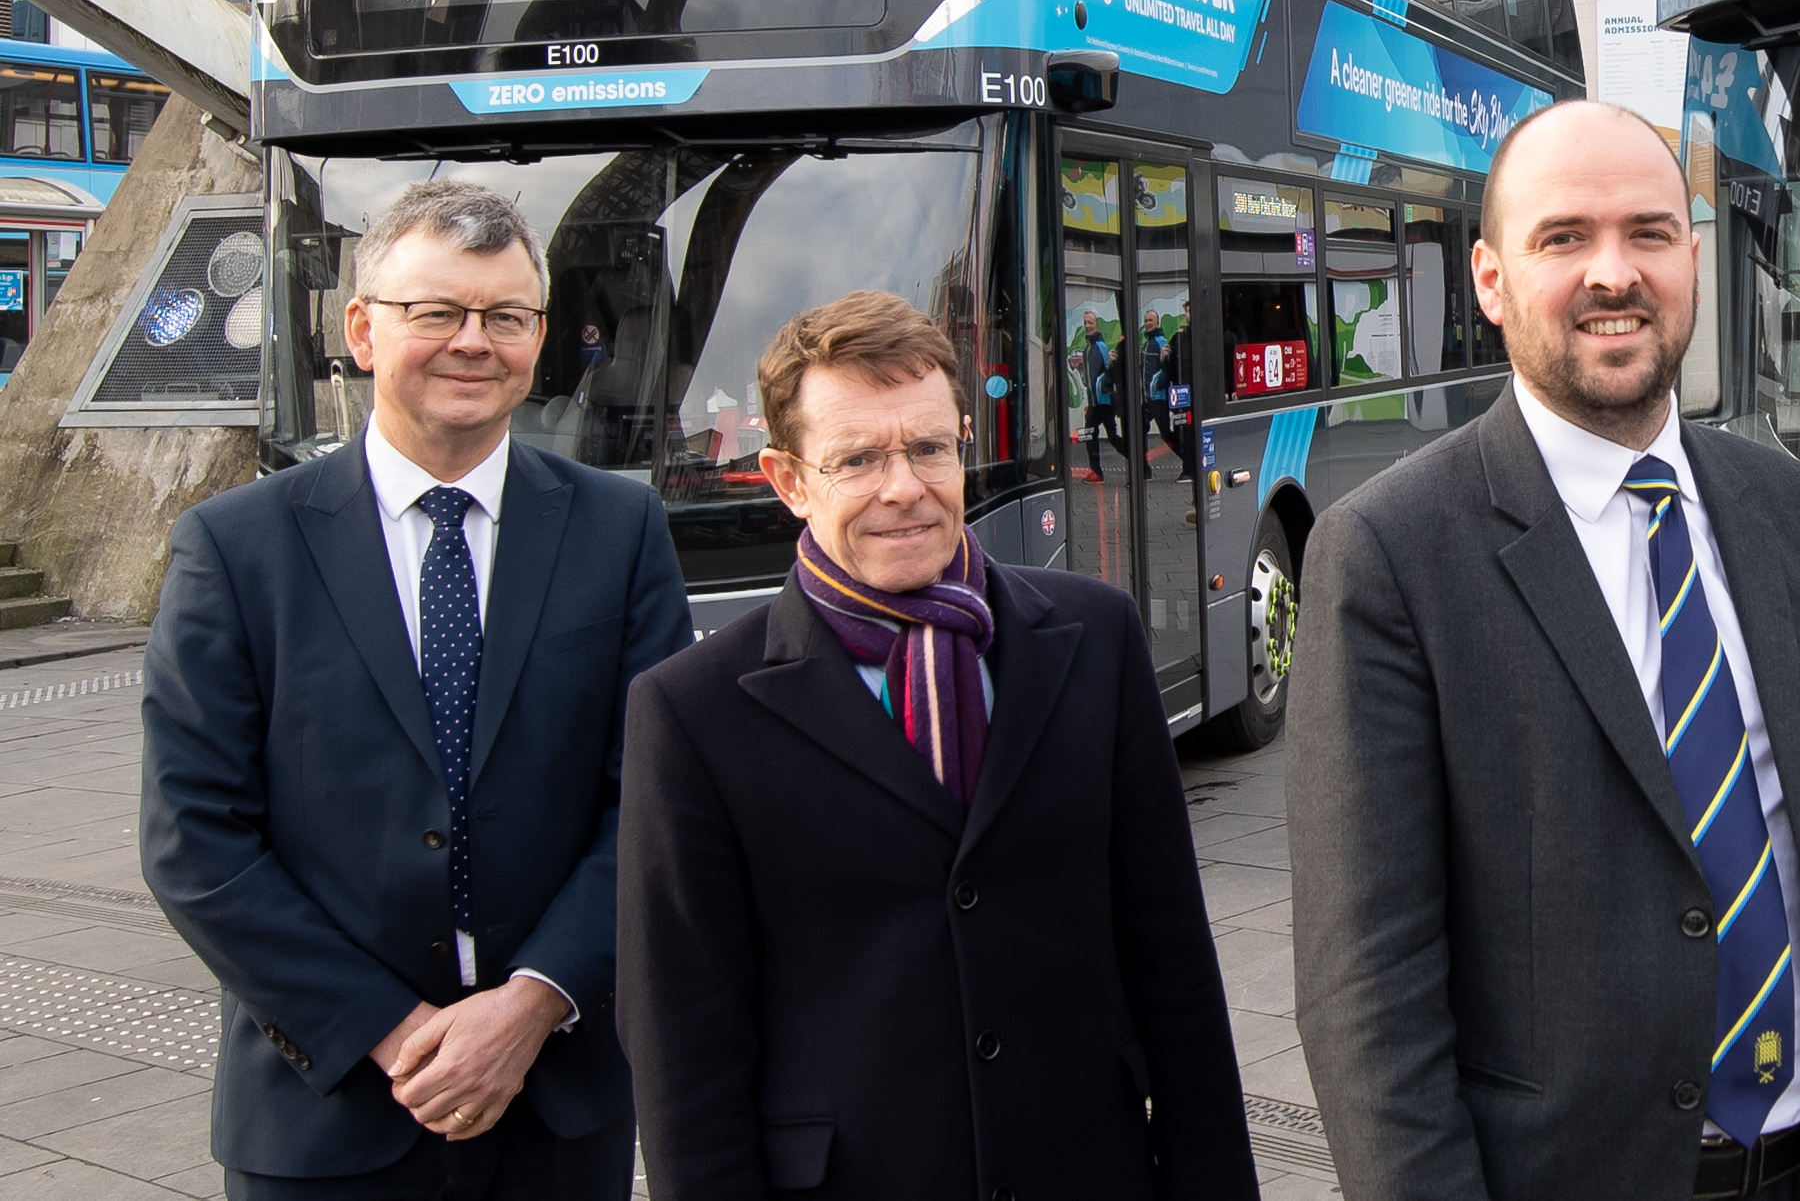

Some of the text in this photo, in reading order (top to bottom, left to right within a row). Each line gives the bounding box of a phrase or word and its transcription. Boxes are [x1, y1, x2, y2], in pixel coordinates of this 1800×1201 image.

[1174, 5, 1206, 35] TRAVEL
[1206, 16, 1220, 40] ALL
[1220, 20, 1236, 44] DAY
[1604, 15, 1644, 26] ANNUAL
[1604, 24, 1660, 35] ADMISSION
[546, 43, 600, 66] E100
[488, 79, 667, 106] ZERO emissions
[980, 71, 1047, 108] E100
[1330, 47, 1342, 88] A
[1342, 52, 1383, 101] cleaner
[1384, 77, 1422, 113] greener
[1423, 81, 1441, 119] ride
[1441, 87, 1456, 123] for
[1455, 92, 1469, 128] the
[1469, 89, 1490, 149] Sky
